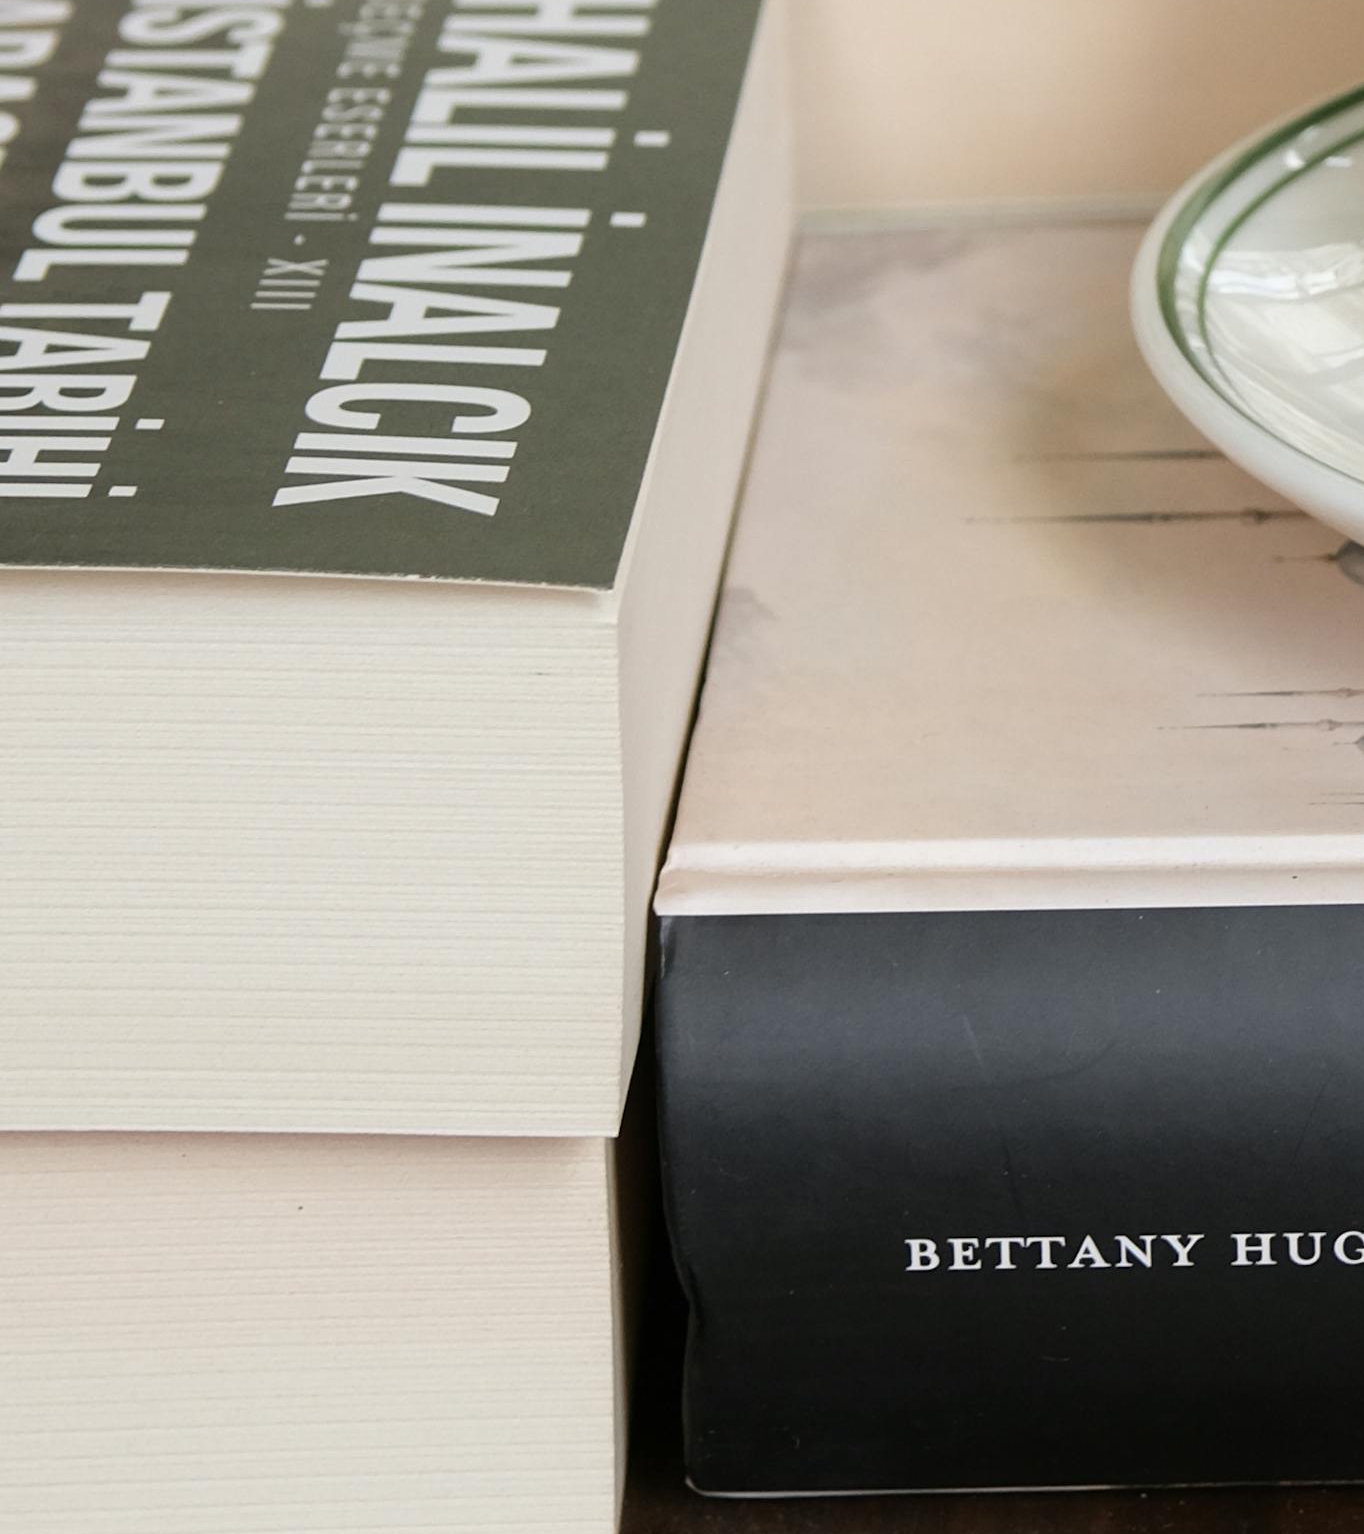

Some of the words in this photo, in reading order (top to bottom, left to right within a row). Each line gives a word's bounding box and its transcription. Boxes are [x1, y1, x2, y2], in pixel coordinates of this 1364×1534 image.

[286, 86, 390, 222] ESERLERİ
[251, 257, 329, 310] XIII
[271, 202, 647, 516] İNALCIK
[906, 1233, 1205, 1273] BETTANY
